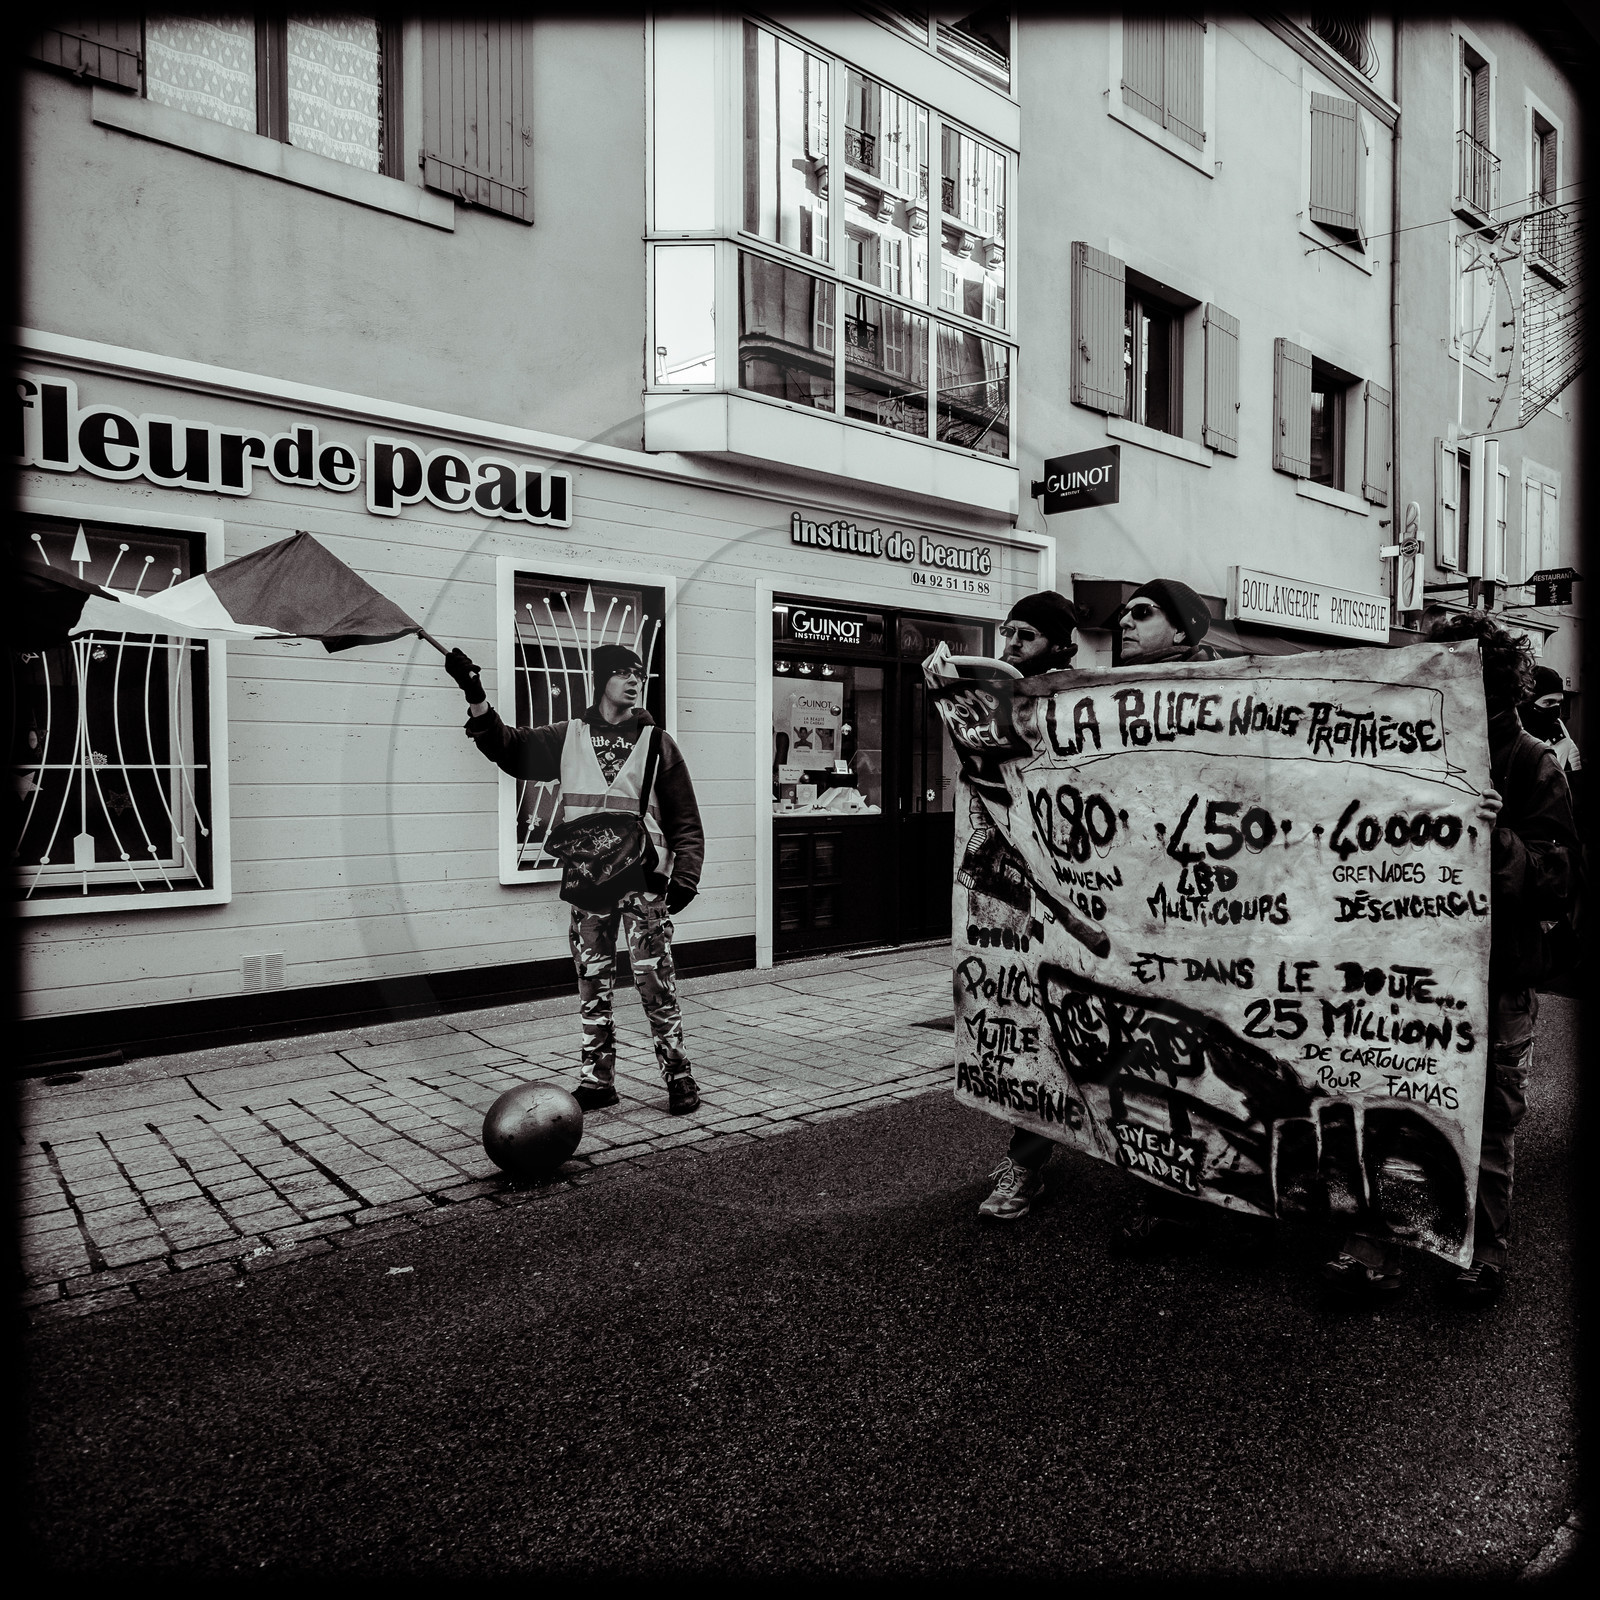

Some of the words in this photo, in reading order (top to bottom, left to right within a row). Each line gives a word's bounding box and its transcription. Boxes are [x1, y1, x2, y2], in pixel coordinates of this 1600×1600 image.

[272, 426, 358, 487] de
[373, 441, 568, 522] peau
[1046, 464, 1113, 493] GUINOT
[791, 512, 882, 556] institut
[887, 532, 915, 561] de
[920, 536, 992, 575] beauté
[912, 571, 926, 586] 04
[930, 573, 943, 588] 92
[946, 576, 959, 590] 51
[962, 578, 975, 592] 15
[977, 581, 991, 595] 88
[1532, 569, 1574, 583] RESTAURANT
[1241, 577, 1321, 621] BOULANGERIE
[1330, 596, 1387, 632] PATISSERIE
[791, 610, 864, 638] GUINOT
[795, 631, 831, 641] INSTITUT
[839, 636, 860, 644] PARIS
[797, 695, 832, 709] GUINOT
[1045, 696, 1101, 757] LA
[1111, 687, 1225, 747] POLICE
[1228, 695, 1305, 737] NOUS
[591, 735, 611, 748] We
[1176, 861, 1240, 897] LBD
[1332, 860, 1426, 884] GRENADES
[1438, 865, 1464, 885] DE
[1130, 951, 1179, 985] ET
[1182, 956, 1256, 990] DANS
[1277, 959, 1321, 993] LE
[1242, 998, 1309, 1041] 25
[980, 1053, 1015, 1077] ET
[1302, 1043, 1331, 1061] DE
[1340, 1047, 1439, 1075] CARTOUCHE
[1317, 1064, 1362, 1089] POUR
[1382, 1074, 1460, 1110] FAMAS
